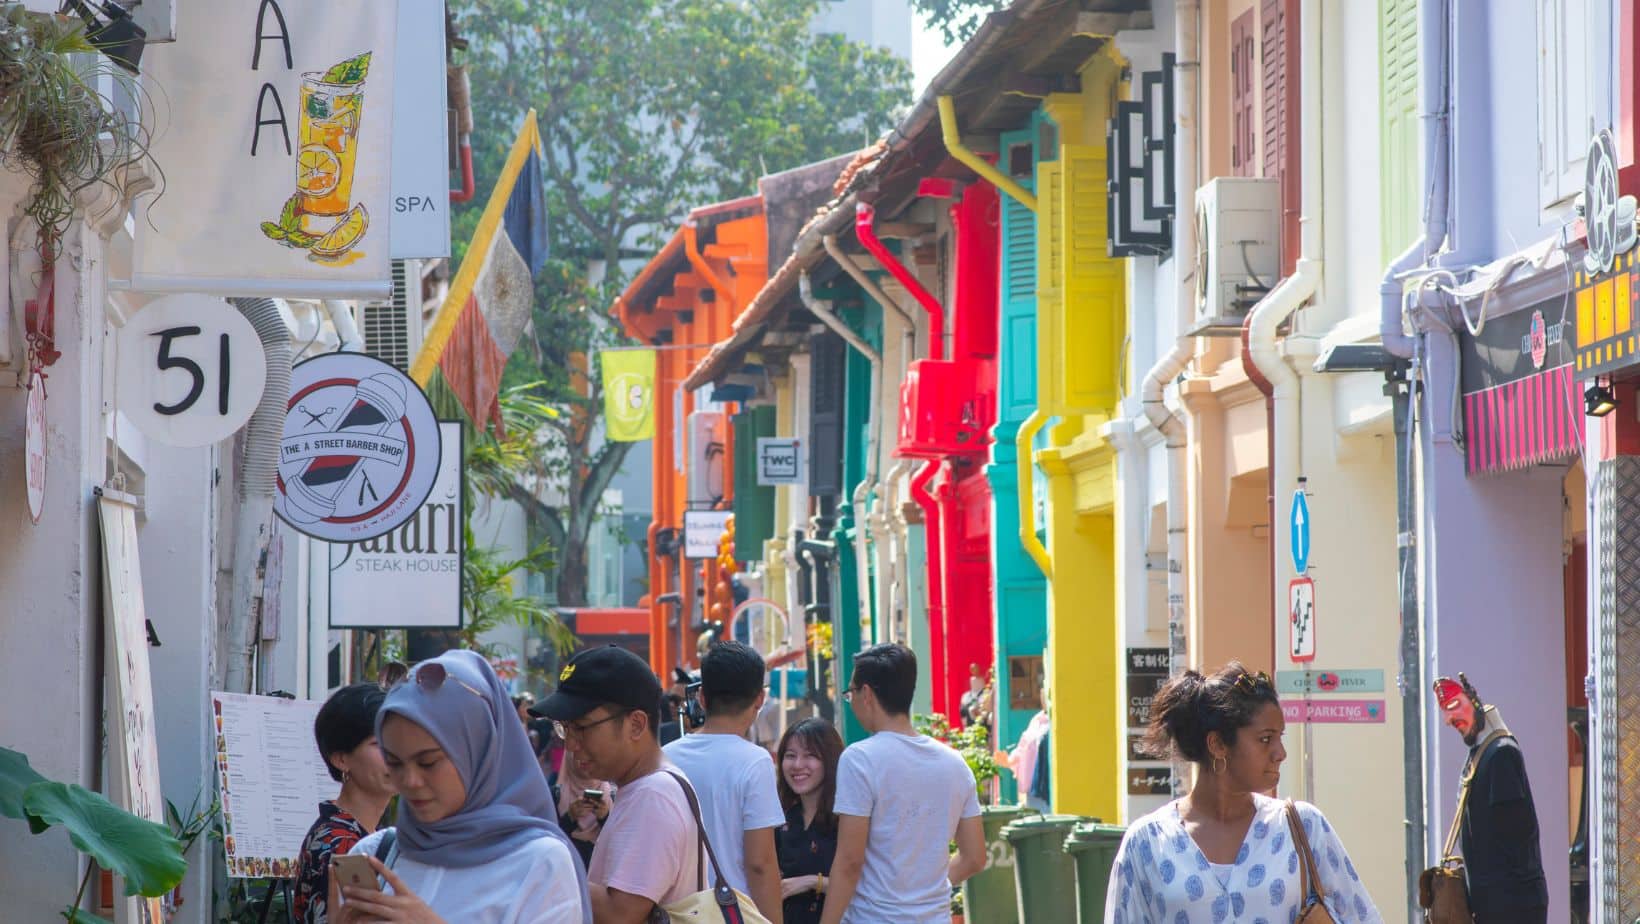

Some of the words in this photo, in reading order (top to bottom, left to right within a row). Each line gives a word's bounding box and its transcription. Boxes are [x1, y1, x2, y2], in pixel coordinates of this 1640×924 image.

[251, 82, 292, 156] A
[395, 196, 435, 212] SPA
[149, 326, 230, 417] 51
[284, 444, 301, 455] THE
[314, 439, 345, 450] STREET
[346, 439, 378, 451] BARBER
[380, 444, 403, 457] SHOP
[760, 455, 794, 466] TWC
[355, 558, 402, 573] STEAK
[405, 558, 457, 573] HOUSE
[1283, 706, 1299, 719] NO
[1306, 705, 1362, 718] PARKING
